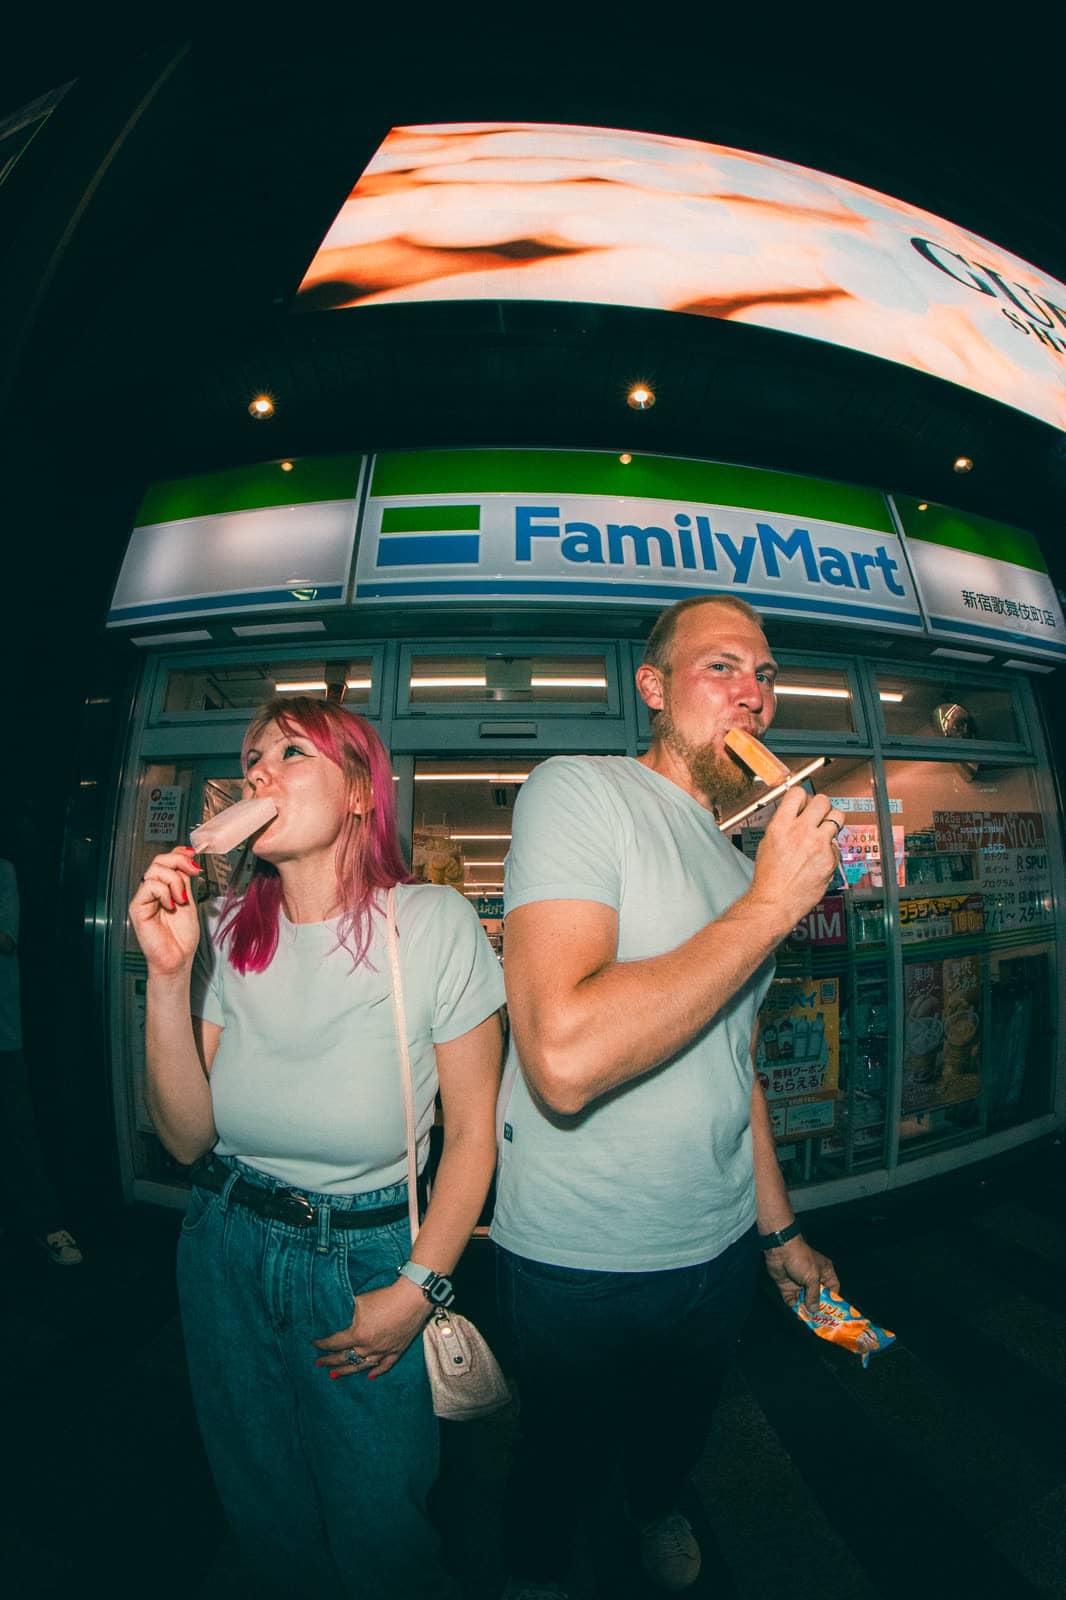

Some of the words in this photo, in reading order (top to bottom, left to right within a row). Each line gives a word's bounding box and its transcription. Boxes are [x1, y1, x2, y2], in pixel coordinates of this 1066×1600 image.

[514, 506, 906, 597] FamilyMart
[961, 590, 1057, 627] 新宿歌舞伎町店
[791, 912, 841, 941] SIM
[773, 1064, 826, 1080] 無料クーポン
